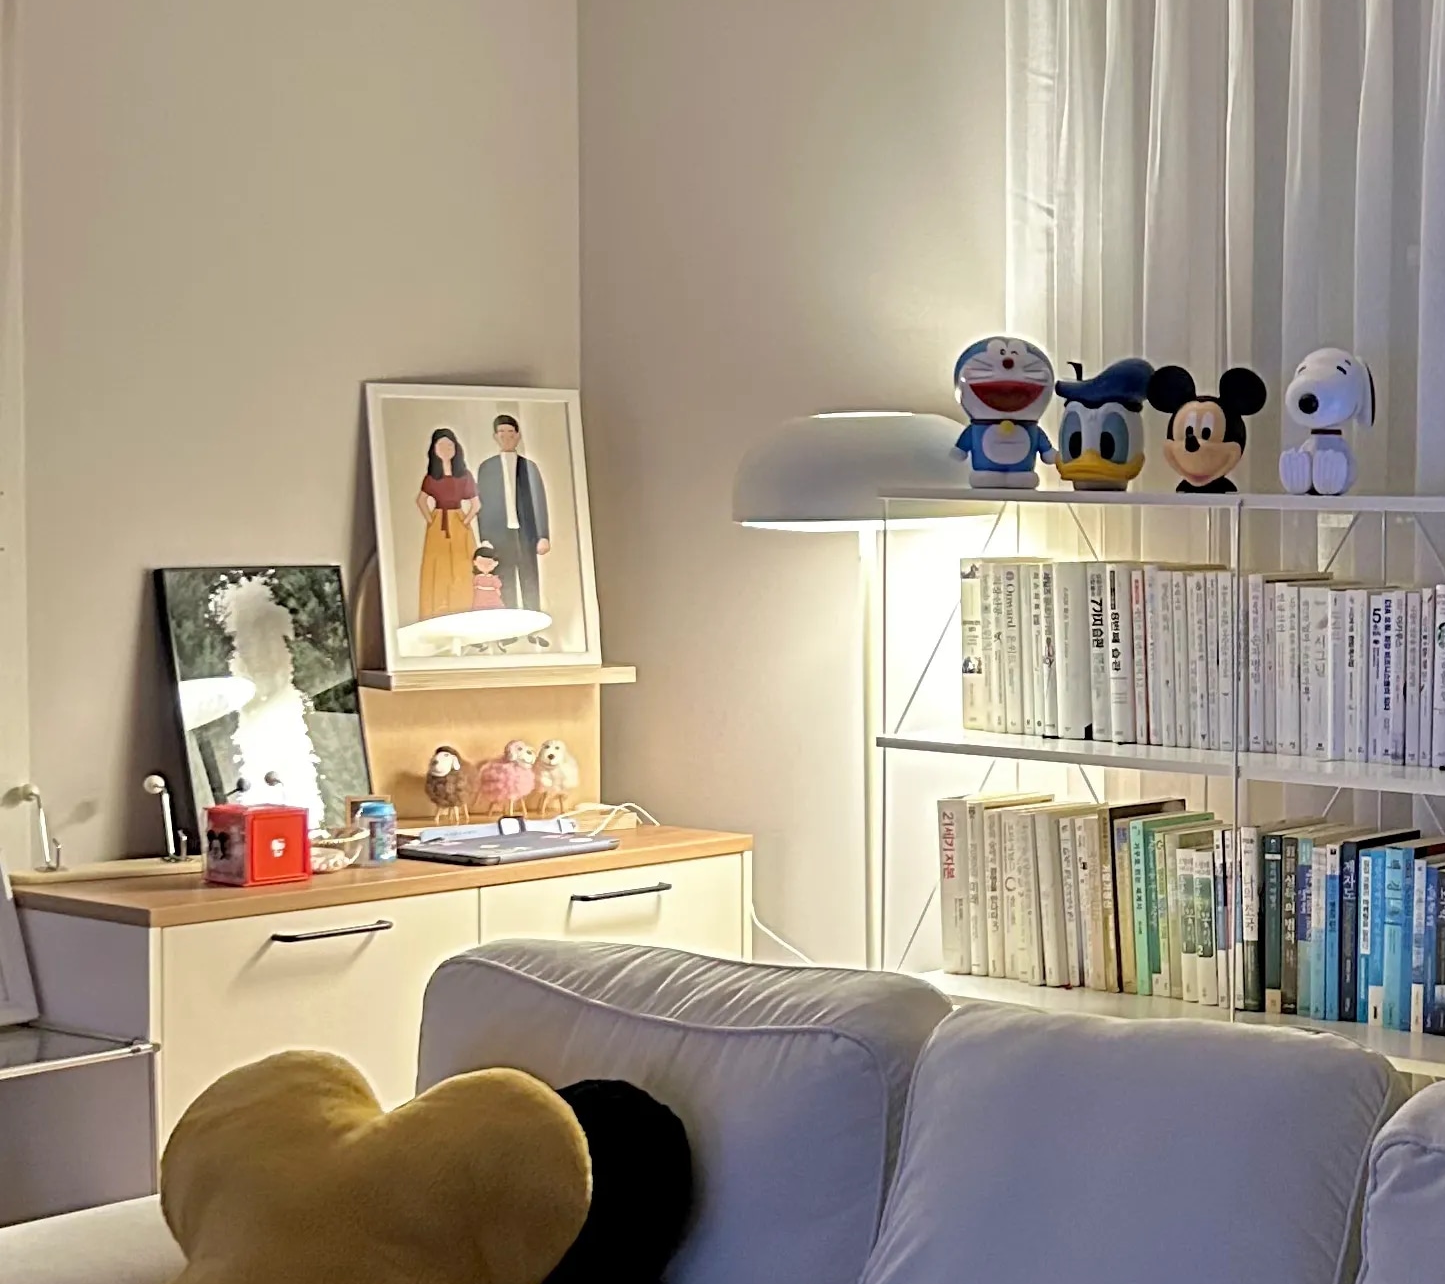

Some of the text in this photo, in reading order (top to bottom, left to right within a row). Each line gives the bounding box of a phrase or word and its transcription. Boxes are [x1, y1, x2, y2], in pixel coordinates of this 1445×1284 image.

[1090, 597, 1104, 627] 7가지
[941, 811, 957, 880] 21세기 자본
